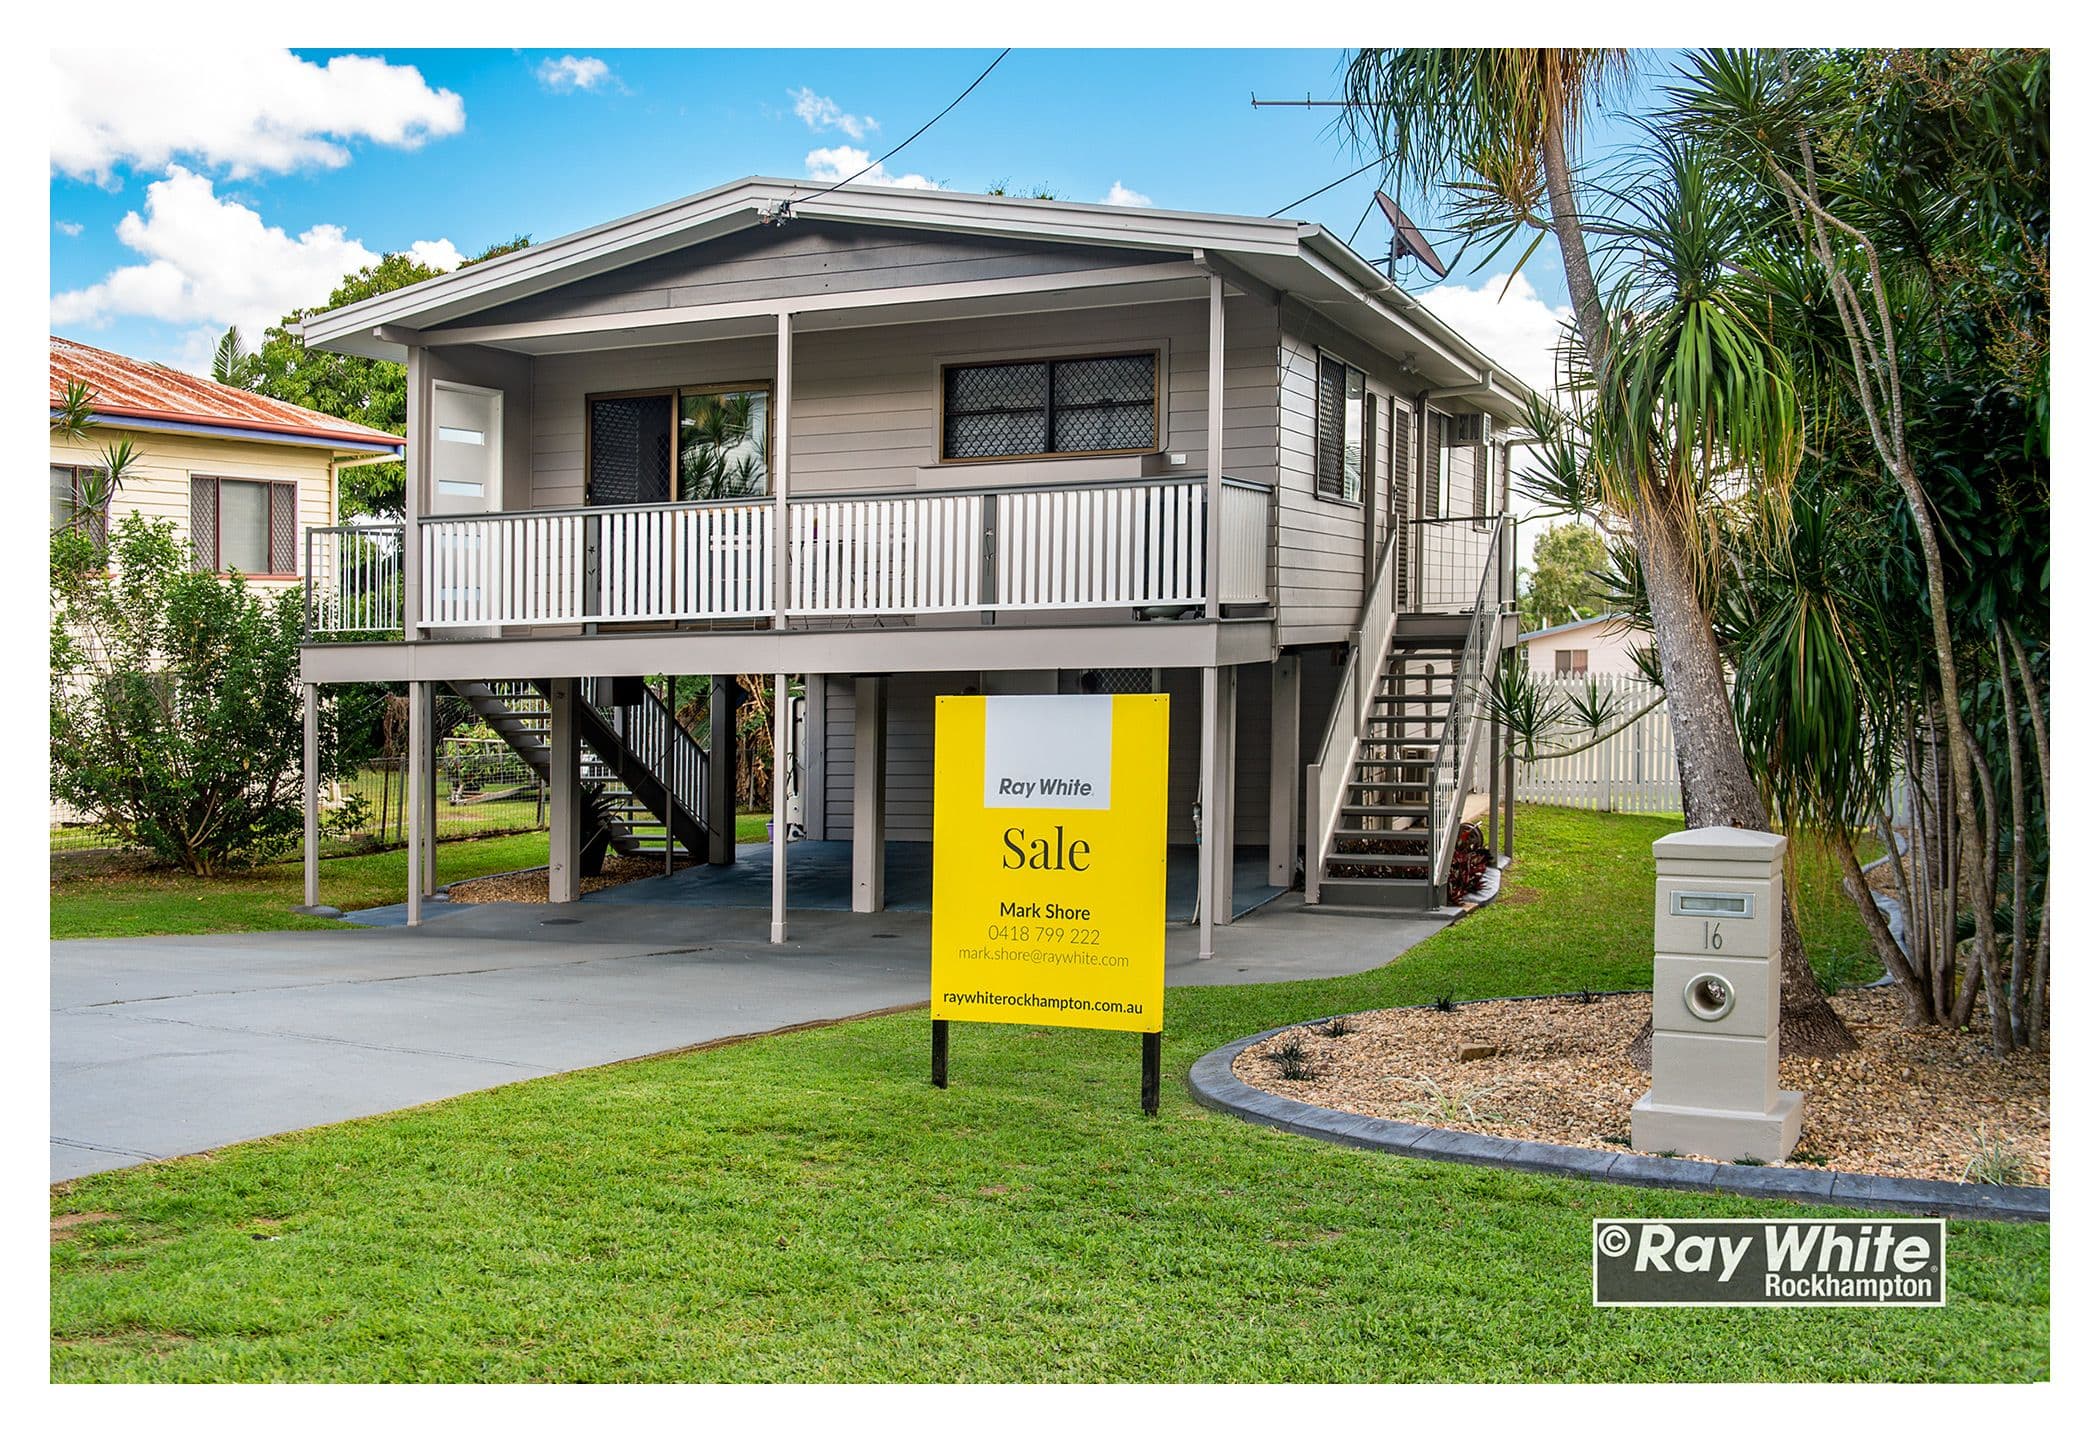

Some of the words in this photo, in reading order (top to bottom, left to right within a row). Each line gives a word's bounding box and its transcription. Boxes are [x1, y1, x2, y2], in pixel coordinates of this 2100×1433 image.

[999, 777, 1036, 798] Ray
[1040, 778, 1092, 796] White
[1002, 825, 1090, 871] Sale
[1000, 902, 1041, 919] Mark
[1045, 903, 1091, 920] Shore
[988, 924, 1030, 941] 0418
[1036, 926, 1064, 943] 799
[1070, 928, 1100, 945] 222
[1704, 921, 1723, 950] 16
[958, 946, 1129, 968] mark.shore@raywhite.com
[943, 990, 1143, 1015] raywhiterockhampton.com.au
